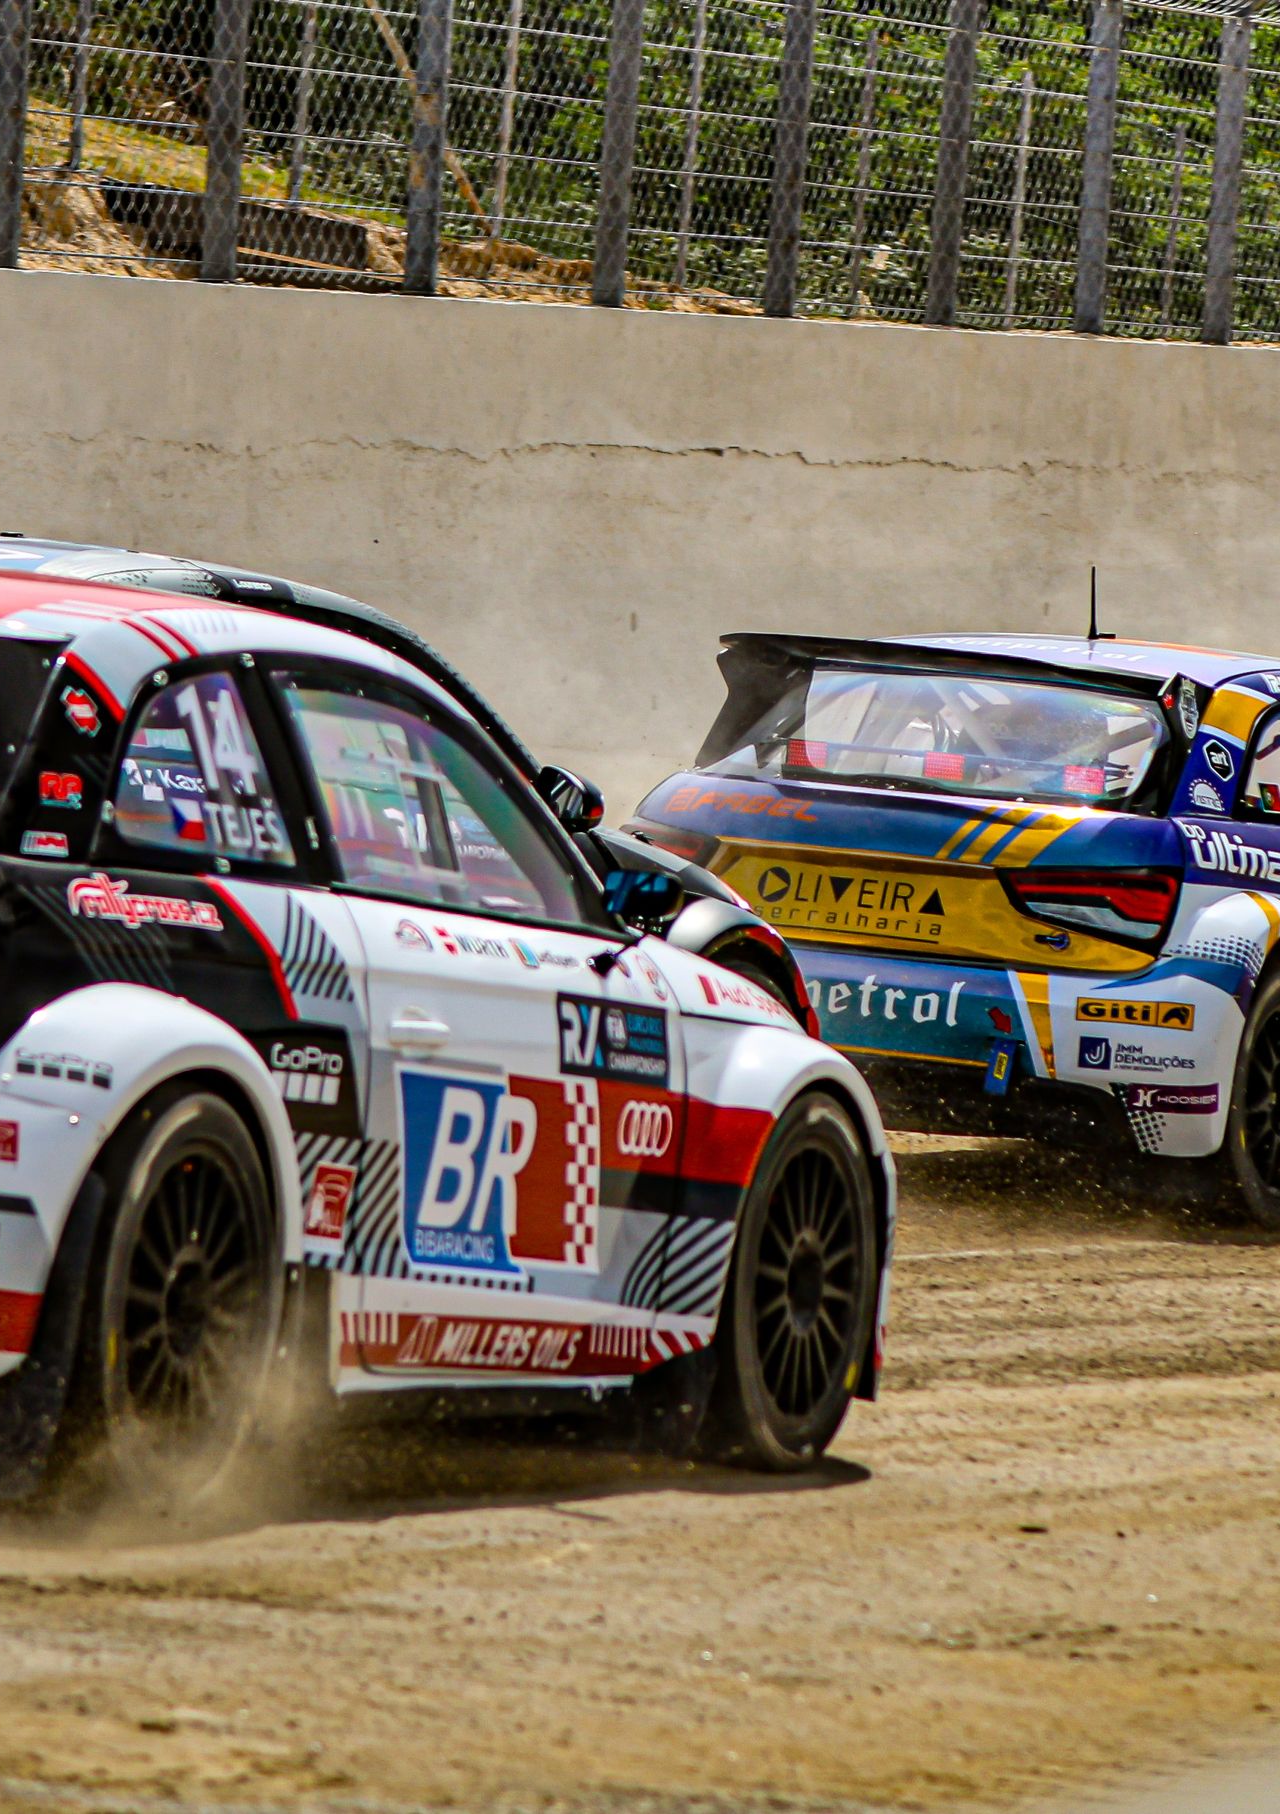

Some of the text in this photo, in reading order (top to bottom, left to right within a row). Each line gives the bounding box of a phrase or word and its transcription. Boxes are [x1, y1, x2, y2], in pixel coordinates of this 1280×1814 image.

[175, 684, 259, 795] 14
[1209, 751, 1229, 768] art
[203, 797, 285, 853] TEJEŠ
[1179, 819, 1208, 844] bp
[756, 865, 946, 917] OLIVEIRA
[755, 904, 943, 937] serralharia
[1079, 1001, 1151, 1022] Giti
[270, 1042, 344, 1076] GoPro
[1114, 1052, 1196, 1071] DEMOLIÇÕES
[1115, 1042, 1144, 1055] JMM
[1156, 1093, 1217, 1105] HOOSIER
[416, 1085, 538, 1236] BR
[414, 1228, 495, 1264] BIBARACING
[432, 1320, 583, 1371] MILLERS OILS
